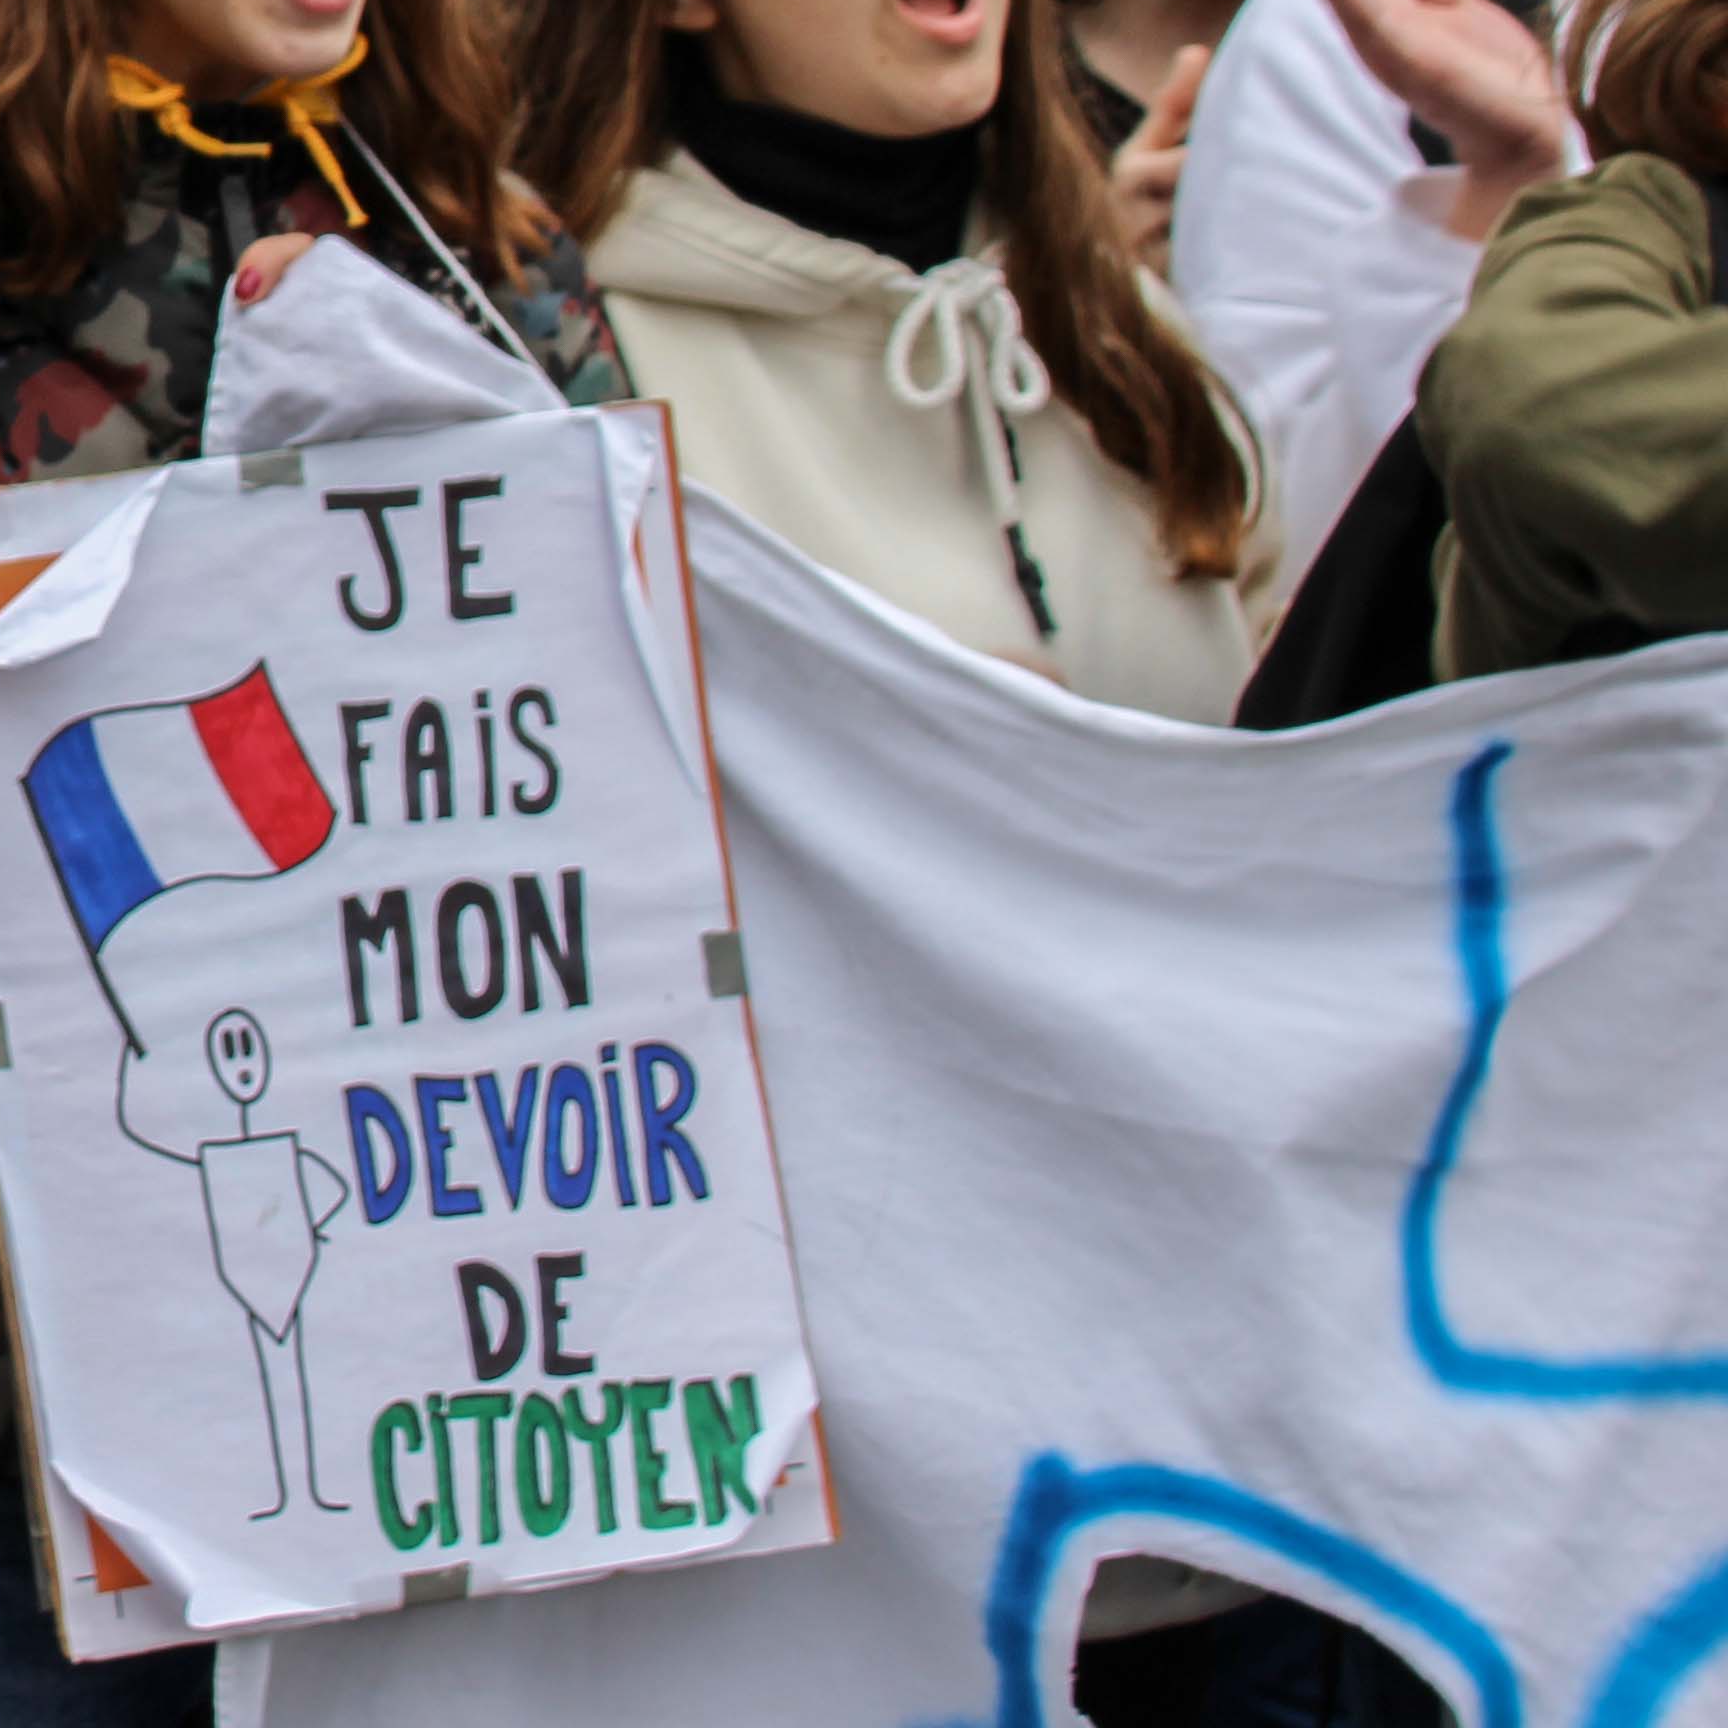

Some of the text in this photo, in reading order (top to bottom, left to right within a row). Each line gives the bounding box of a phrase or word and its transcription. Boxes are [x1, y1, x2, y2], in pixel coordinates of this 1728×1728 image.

[324, 476, 515, 632] JE
[340, 868, 591, 1027] MON
[456, 1250, 595, 1381] DE
